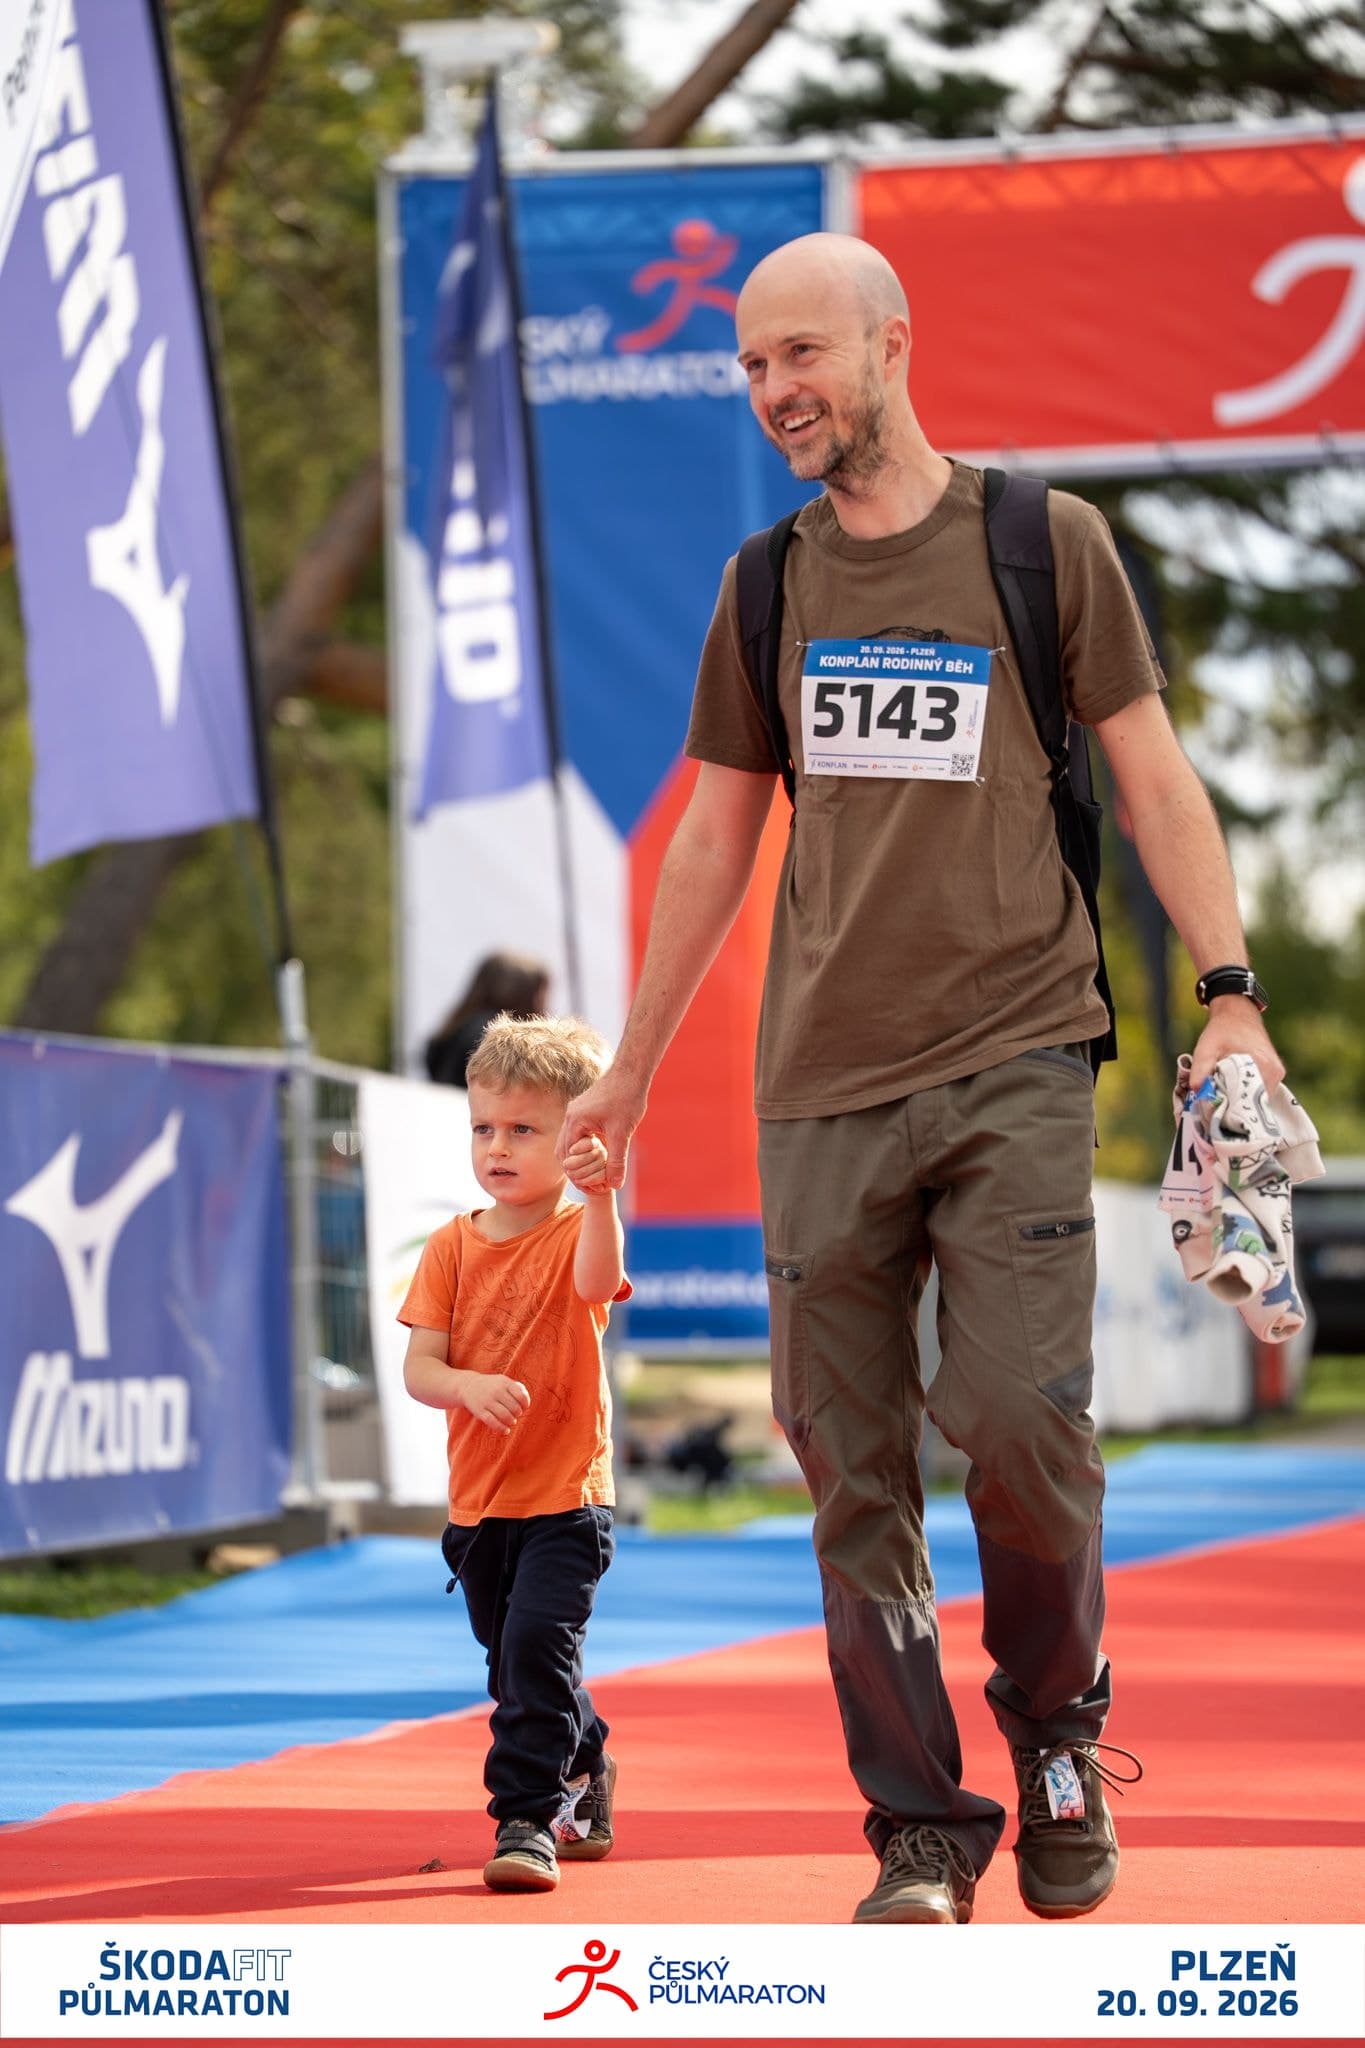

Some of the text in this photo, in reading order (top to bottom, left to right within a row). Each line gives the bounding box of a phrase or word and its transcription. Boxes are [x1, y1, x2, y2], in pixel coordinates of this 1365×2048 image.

[518, 305, 610, 354] SKÝ
[819, 655, 974, 674] KONPLAN RODINNÝ BĚH
[813, 683, 960, 742] 5143
[817, 760, 848, 769] KONPLAN
